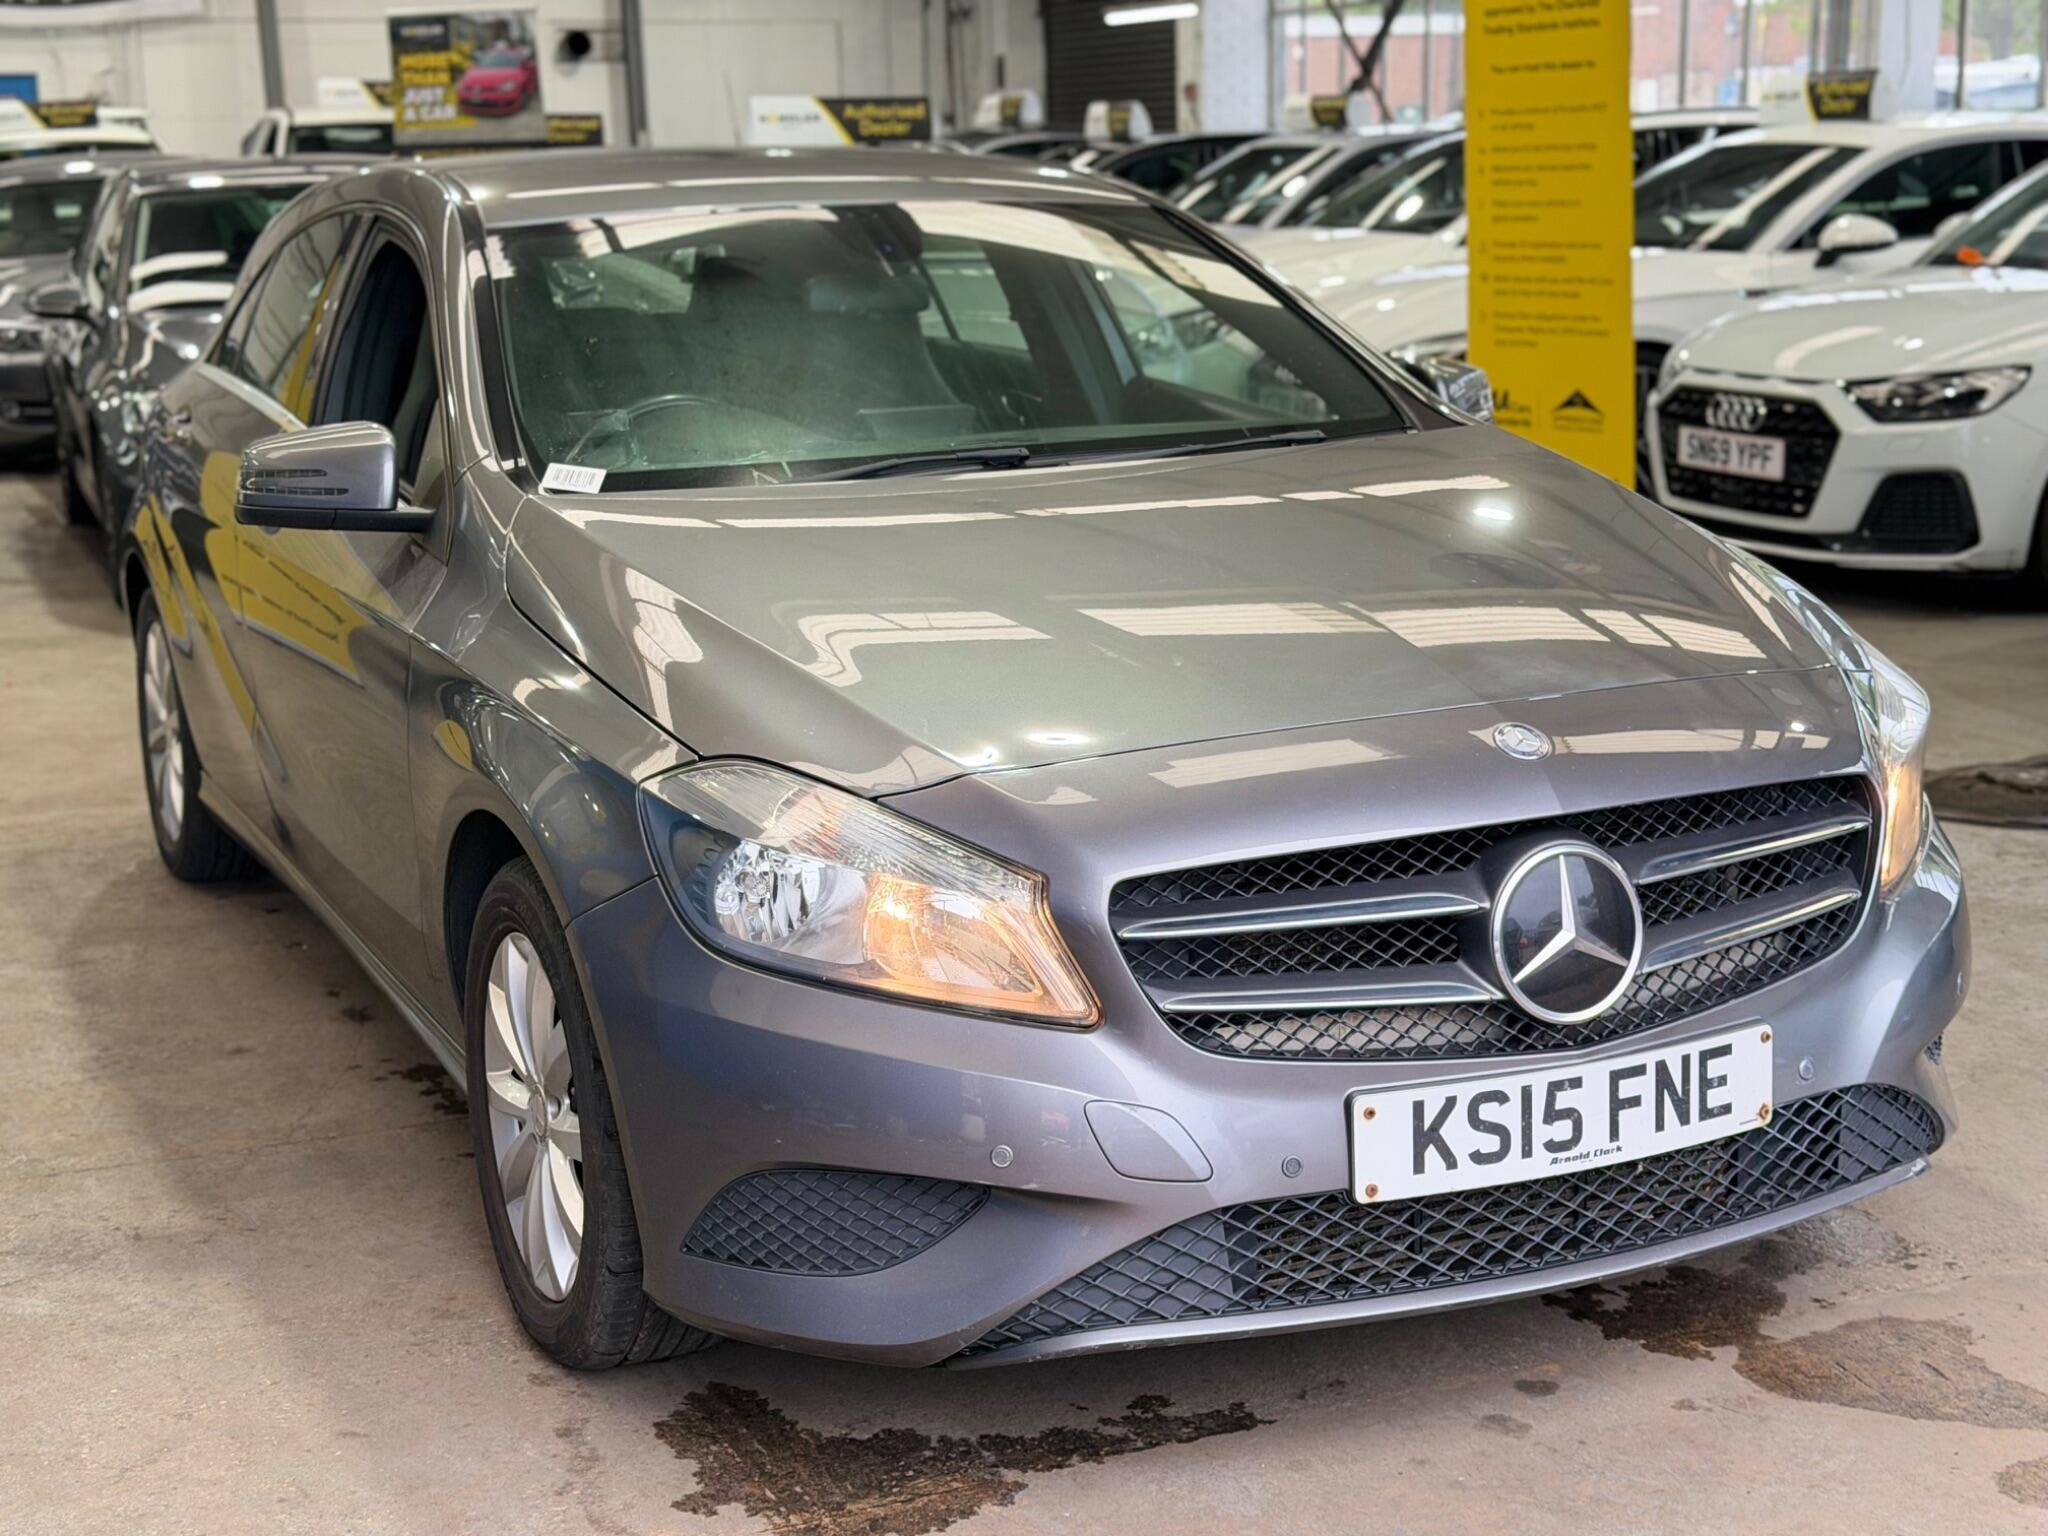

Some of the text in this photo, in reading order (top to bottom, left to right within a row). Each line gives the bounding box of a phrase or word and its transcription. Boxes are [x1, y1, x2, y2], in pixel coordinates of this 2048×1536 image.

[1737, 441, 1774, 472] YPF
[1412, 1043, 1734, 1176] KS15 FNE
[1549, 1144, 1623, 1166] Arnold Clark
